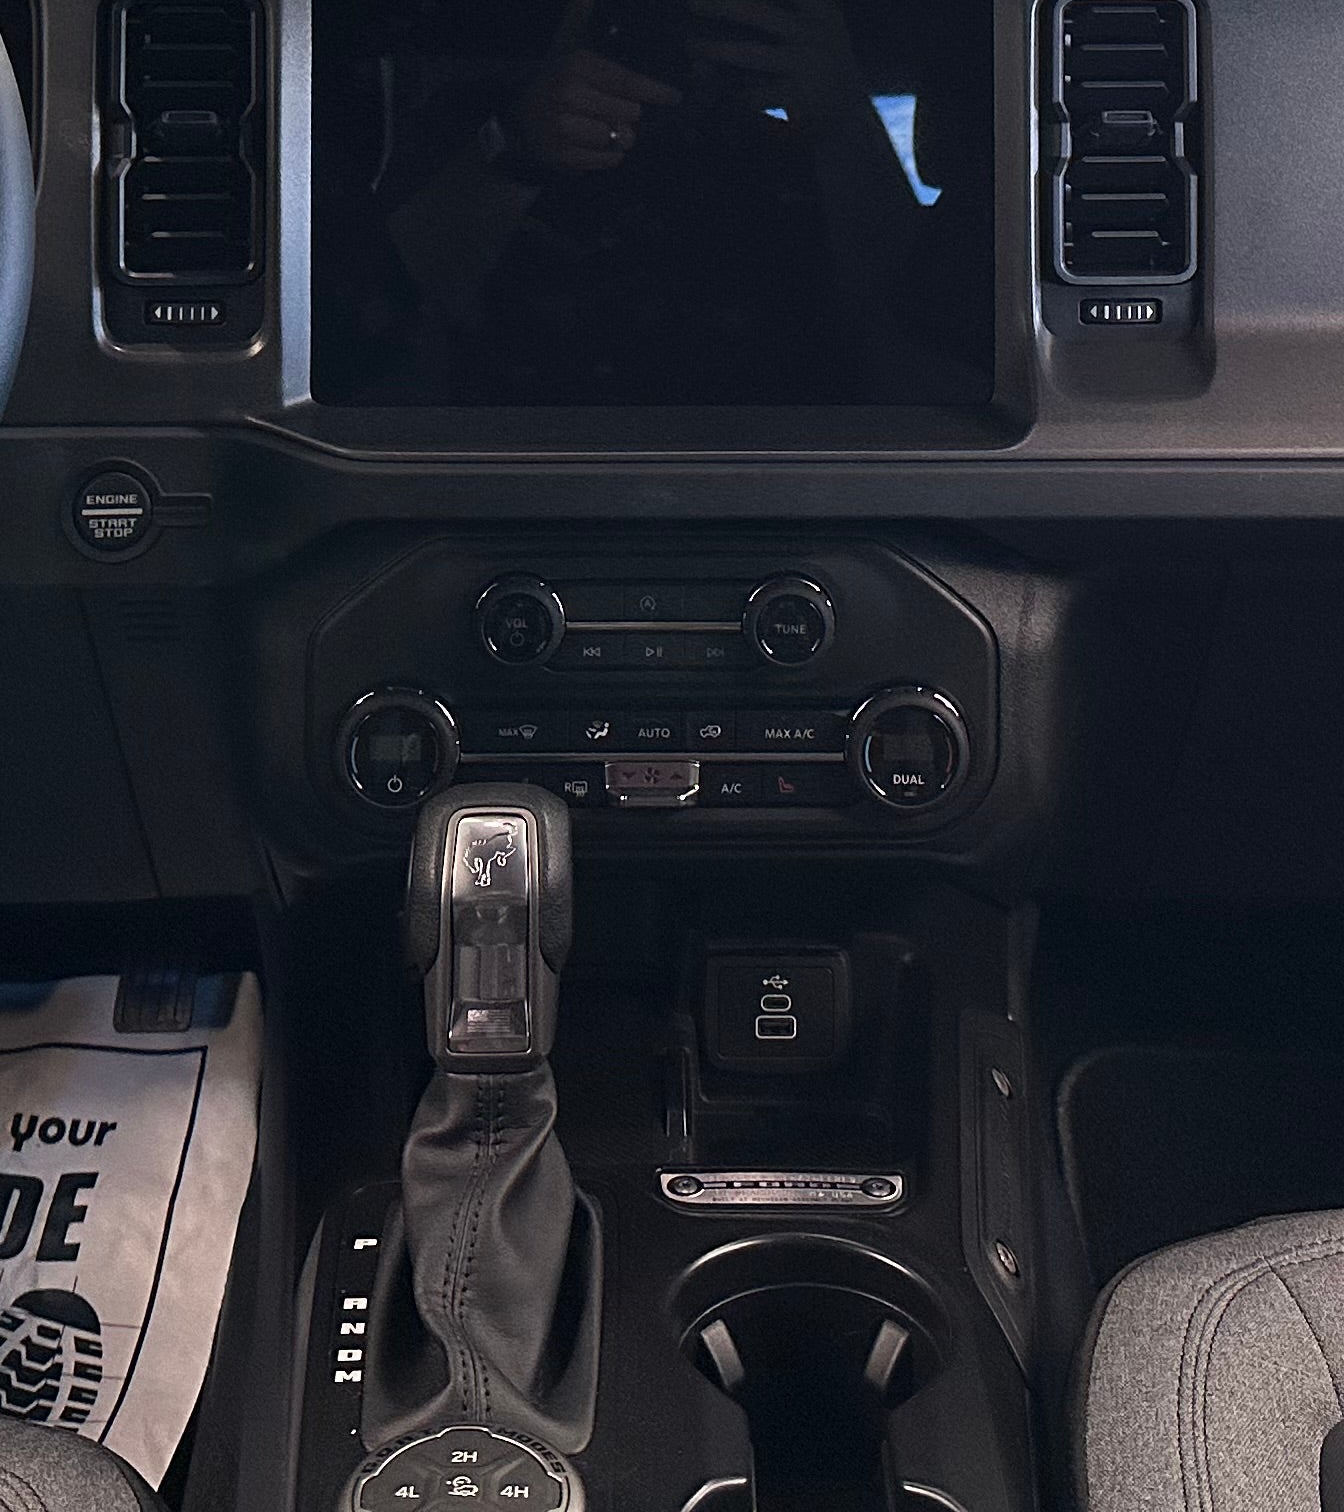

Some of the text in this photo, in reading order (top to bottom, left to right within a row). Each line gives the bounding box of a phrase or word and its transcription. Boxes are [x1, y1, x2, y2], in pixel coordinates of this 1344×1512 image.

[86, 494, 138, 505] ENGINE
[88, 518, 137, 529] START
[94, 528, 134, 539] STOP
[505, 618, 528, 629] VOL
[774, 623, 807, 635] TUNE
[498, 727, 519, 737] MAX
[637, 727, 671, 739] AUTO
[765, 727, 815, 740] MAX A/C
[893, 774, 925, 786] DUAL
[721, 782, 742, 794] A/C
[10, 1112, 117, 1152] your
[353, 1238, 378, 1250] P
[340, 1322, 365, 1335] N
[337, 1349, 362, 1362] D
[334, 1370, 362, 1383] M
[451, 1451, 478, 1463] 2H
[394, 1486, 420, 1498] 4L
[499, 1486, 529, 1498] 4H
